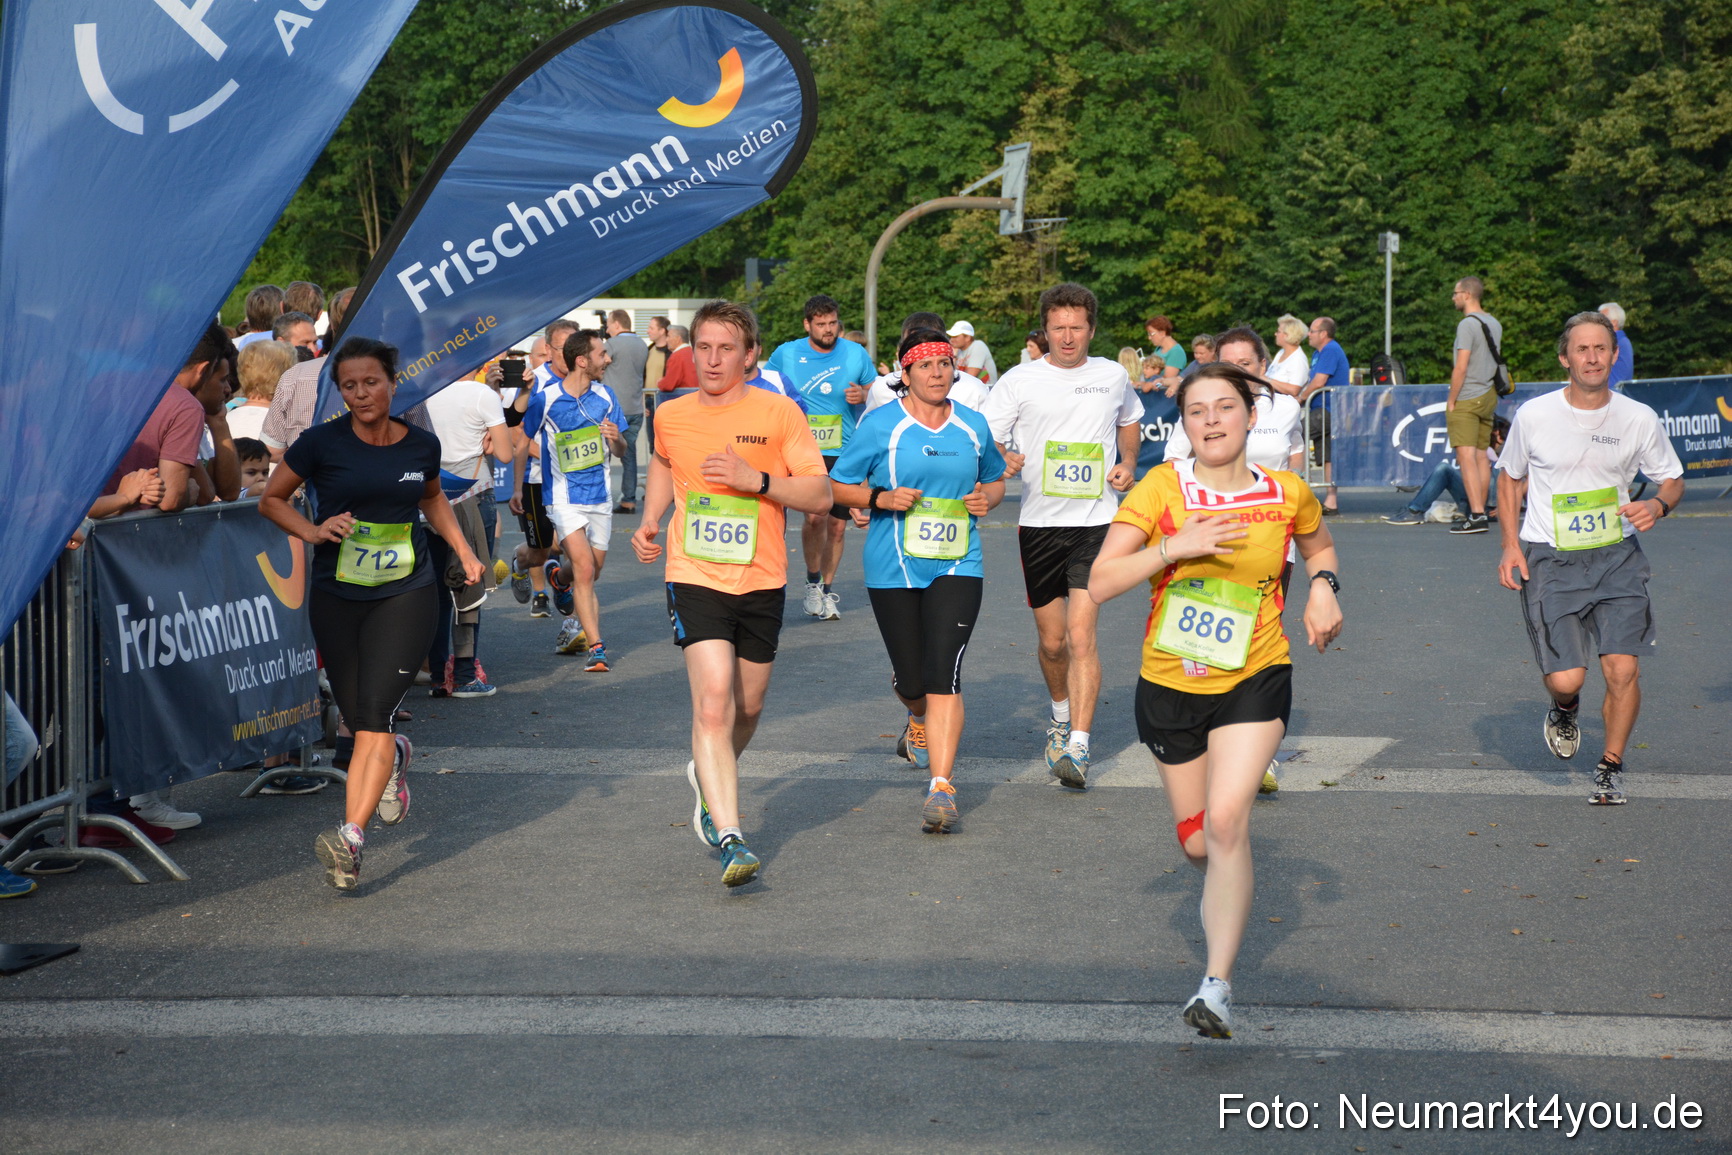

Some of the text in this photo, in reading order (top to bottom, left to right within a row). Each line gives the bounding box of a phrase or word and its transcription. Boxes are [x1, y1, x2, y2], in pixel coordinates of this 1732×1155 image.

[589, 118, 788, 238] Druck und Medien
[396, 134, 690, 314] Frischmann
[1660, 409, 1721, 437] hmann
[562, 441, 598, 460] 1139
[736, 435, 768, 446] THULE
[1591, 434, 1621, 446] ALBERT
[1685, 437, 1707, 452] Druck
[1707, 435, 1723, 450] und
[1054, 464, 1092, 482] 430
[1239, 508, 1287, 524] BÖGL
[1568, 511, 1607, 534] 431
[691, 519, 749, 545] 1566
[918, 521, 958, 542] 520
[354, 546, 399, 571] 712
[115, 591, 279, 674] Frischmann
[1178, 605, 1236, 643] 886
[224, 657, 259, 694] Druck
[259, 649, 286, 685] und
